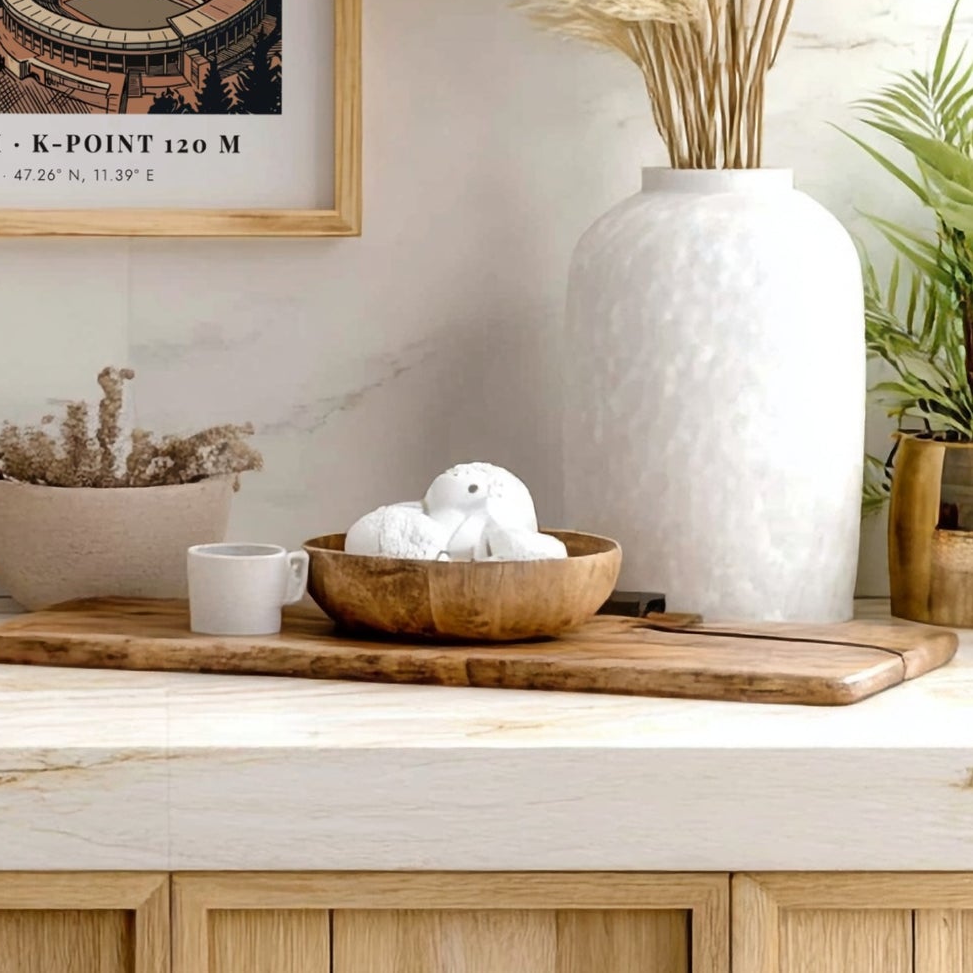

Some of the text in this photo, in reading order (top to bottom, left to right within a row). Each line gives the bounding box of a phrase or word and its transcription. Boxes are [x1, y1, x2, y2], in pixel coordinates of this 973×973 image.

[32, 133, 154, 154] K-POINT
[164, 138, 207, 154] 120
[219, 134, 241, 154] M
[13, 168, 62, 182] 47.26°
[68, 168, 85, 184] N,
[94, 168, 140, 182] 11.39°
[146, 168, 154, 182] E
